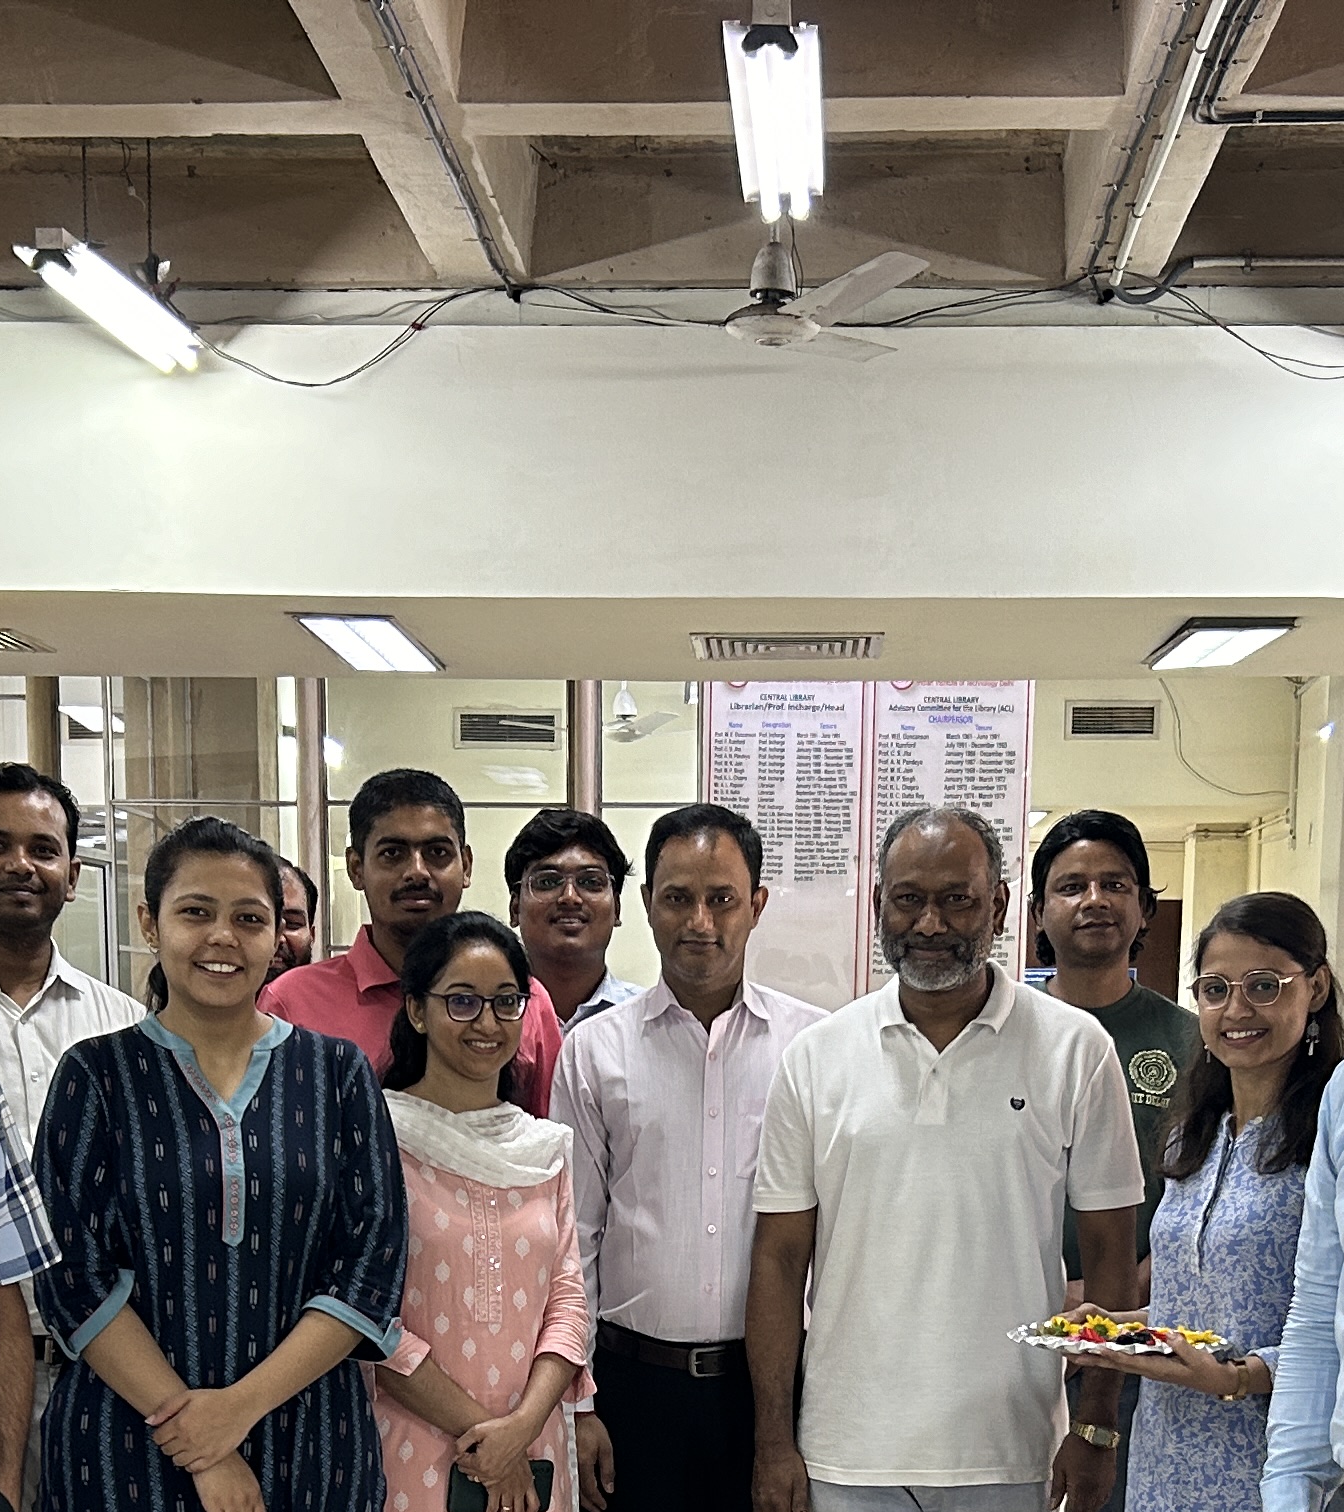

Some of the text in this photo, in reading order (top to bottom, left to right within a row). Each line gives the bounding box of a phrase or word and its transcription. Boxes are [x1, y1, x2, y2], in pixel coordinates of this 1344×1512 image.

[923, 696, 979, 704] CENTRAL LIBRARY
[888, 704, 915, 713] Advisory
[917, 704, 951, 713] Committee
[953, 704, 961, 713] for
[975, 704, 996, 713] Library
